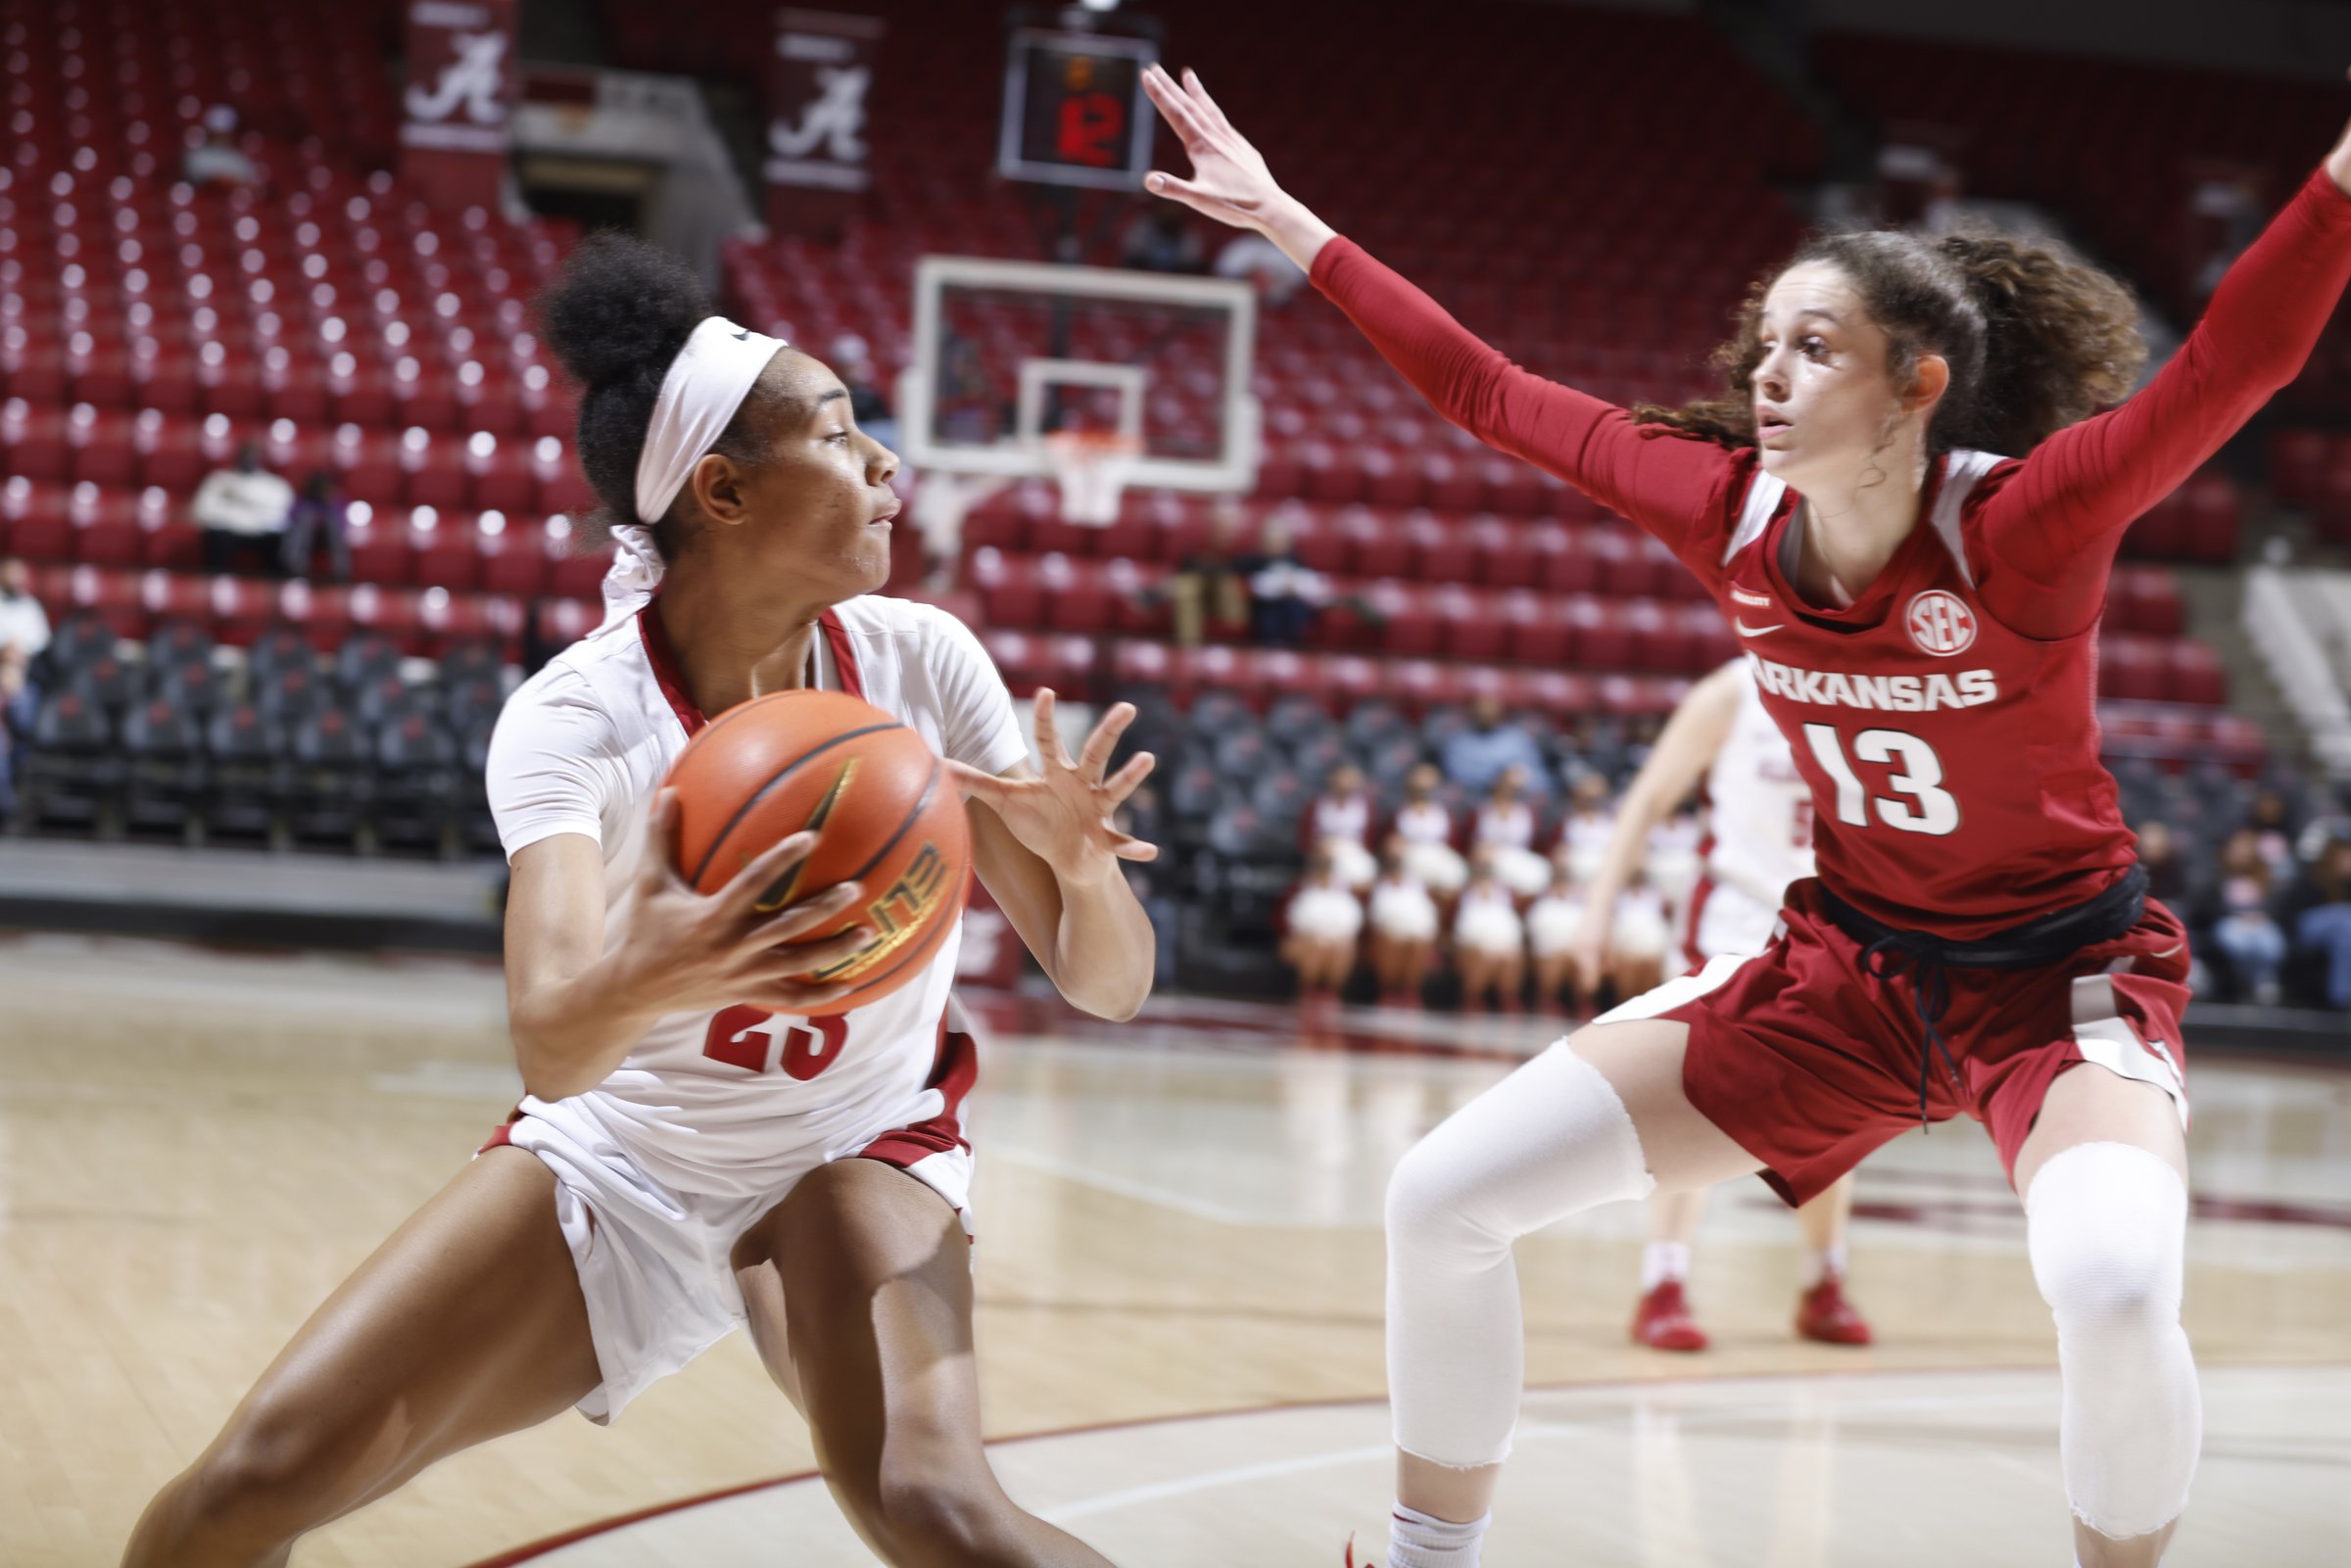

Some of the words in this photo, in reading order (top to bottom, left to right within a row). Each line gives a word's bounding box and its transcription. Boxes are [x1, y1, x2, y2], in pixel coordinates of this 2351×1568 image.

[1910, 594, 1972, 651] SEC
[1802, 721, 1959, 835] 13
[811, 840, 948, 980] ELI
[702, 1003, 848, 1081] 23
